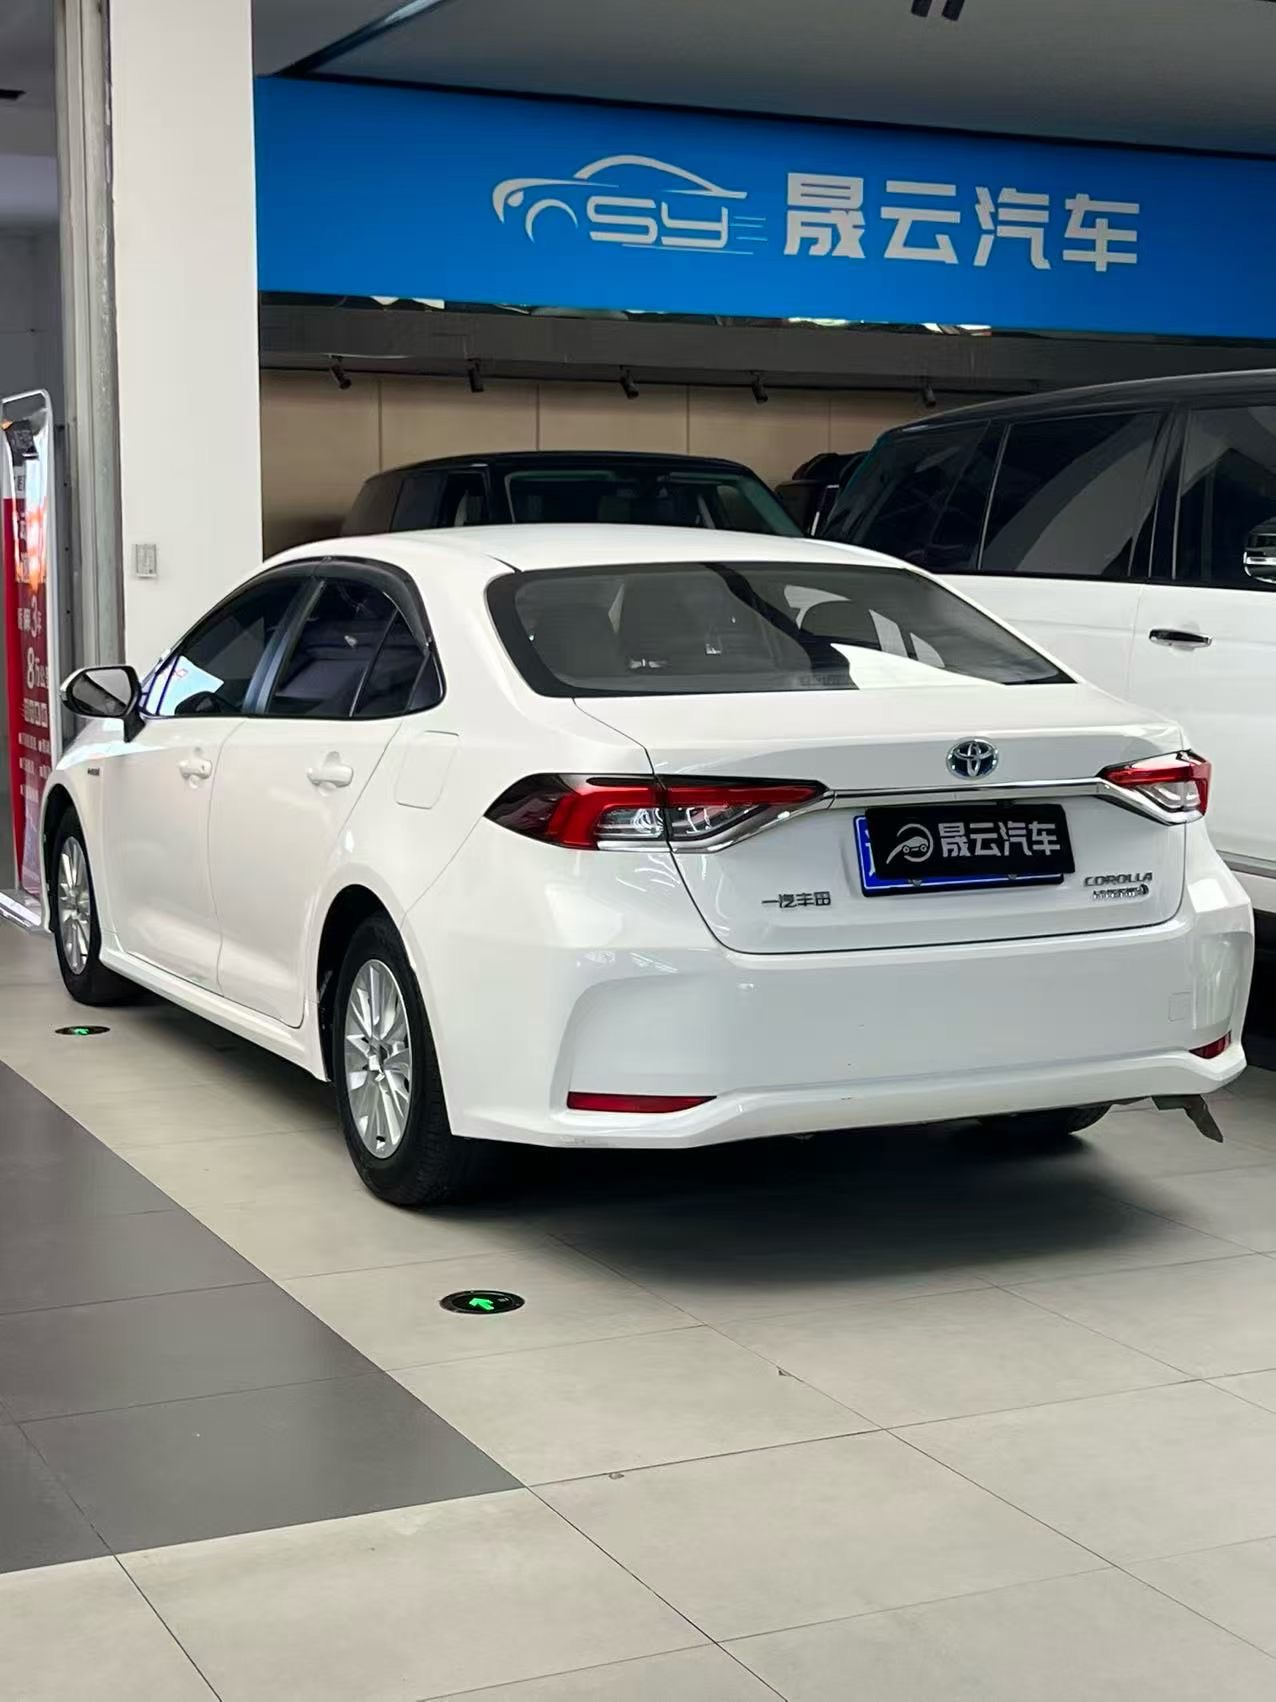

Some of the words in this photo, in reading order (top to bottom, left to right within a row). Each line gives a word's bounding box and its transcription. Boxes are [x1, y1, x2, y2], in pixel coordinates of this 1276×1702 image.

[783, 171, 1141, 272] 晟云汽车
[937, 820, 1062, 858] 晟云汽车
[1083, 871, 1153, 887] COROLLA
[760, 890, 831, 908] 一汽丰田
